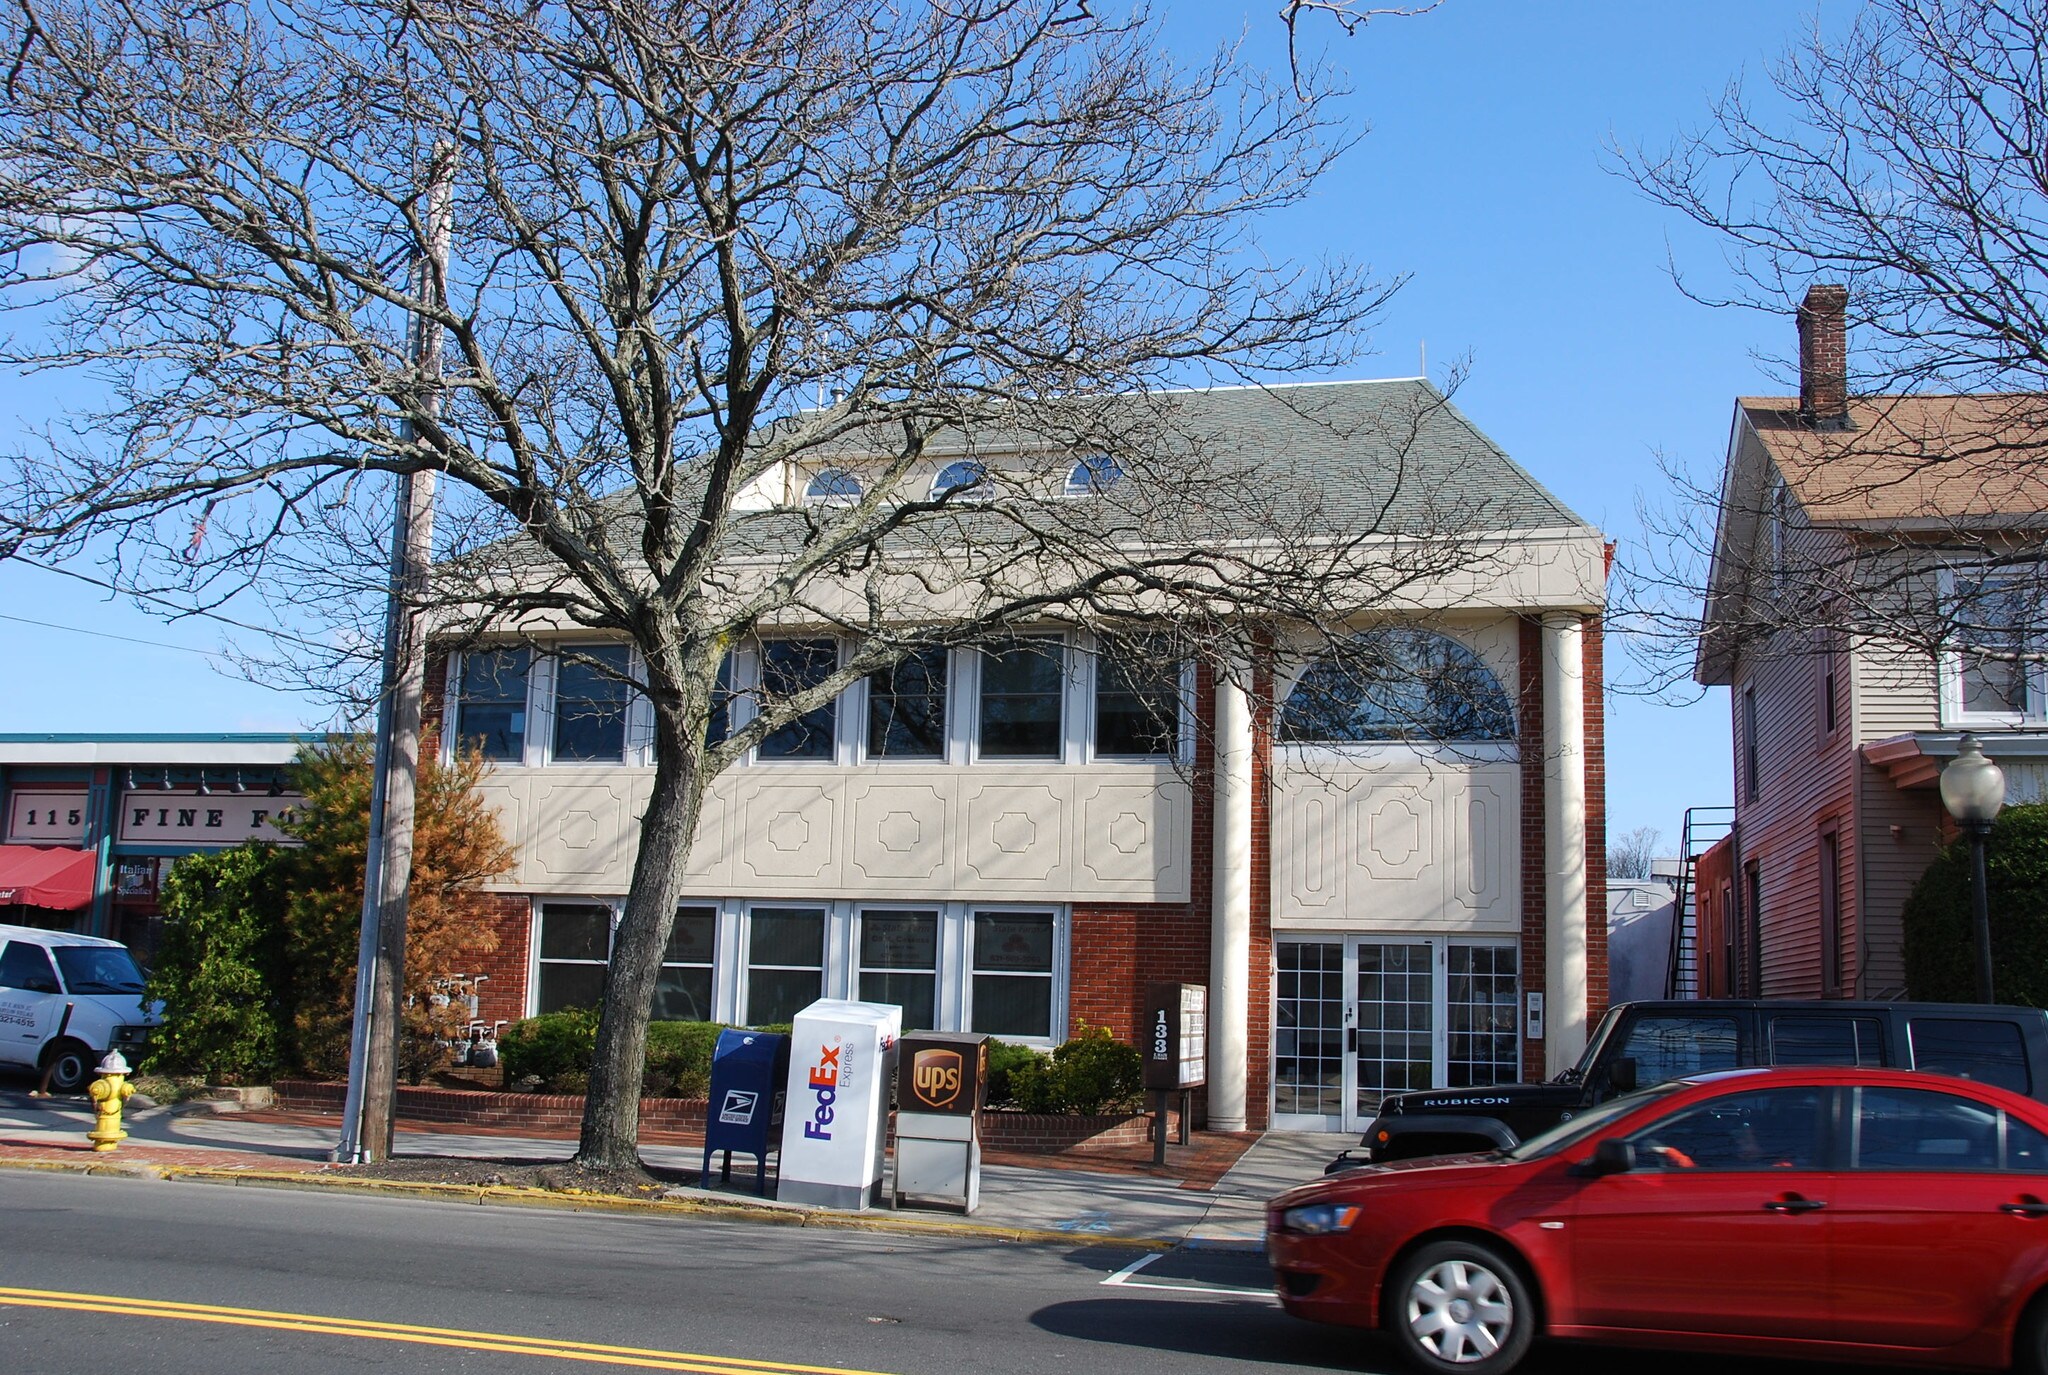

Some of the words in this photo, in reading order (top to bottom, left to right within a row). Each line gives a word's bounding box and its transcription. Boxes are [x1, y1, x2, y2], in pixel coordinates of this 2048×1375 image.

[28, 809, 81, 825] 115
[132, 808, 223, 827] FINE
[1155, 1010, 1168, 1053] 133
[839, 1042, 854, 1088] Express
[804, 1044, 840, 1141] FedEx
[917, 1067, 958, 1098] ups
[1424, 1097, 1510, 1106] RUBICON
